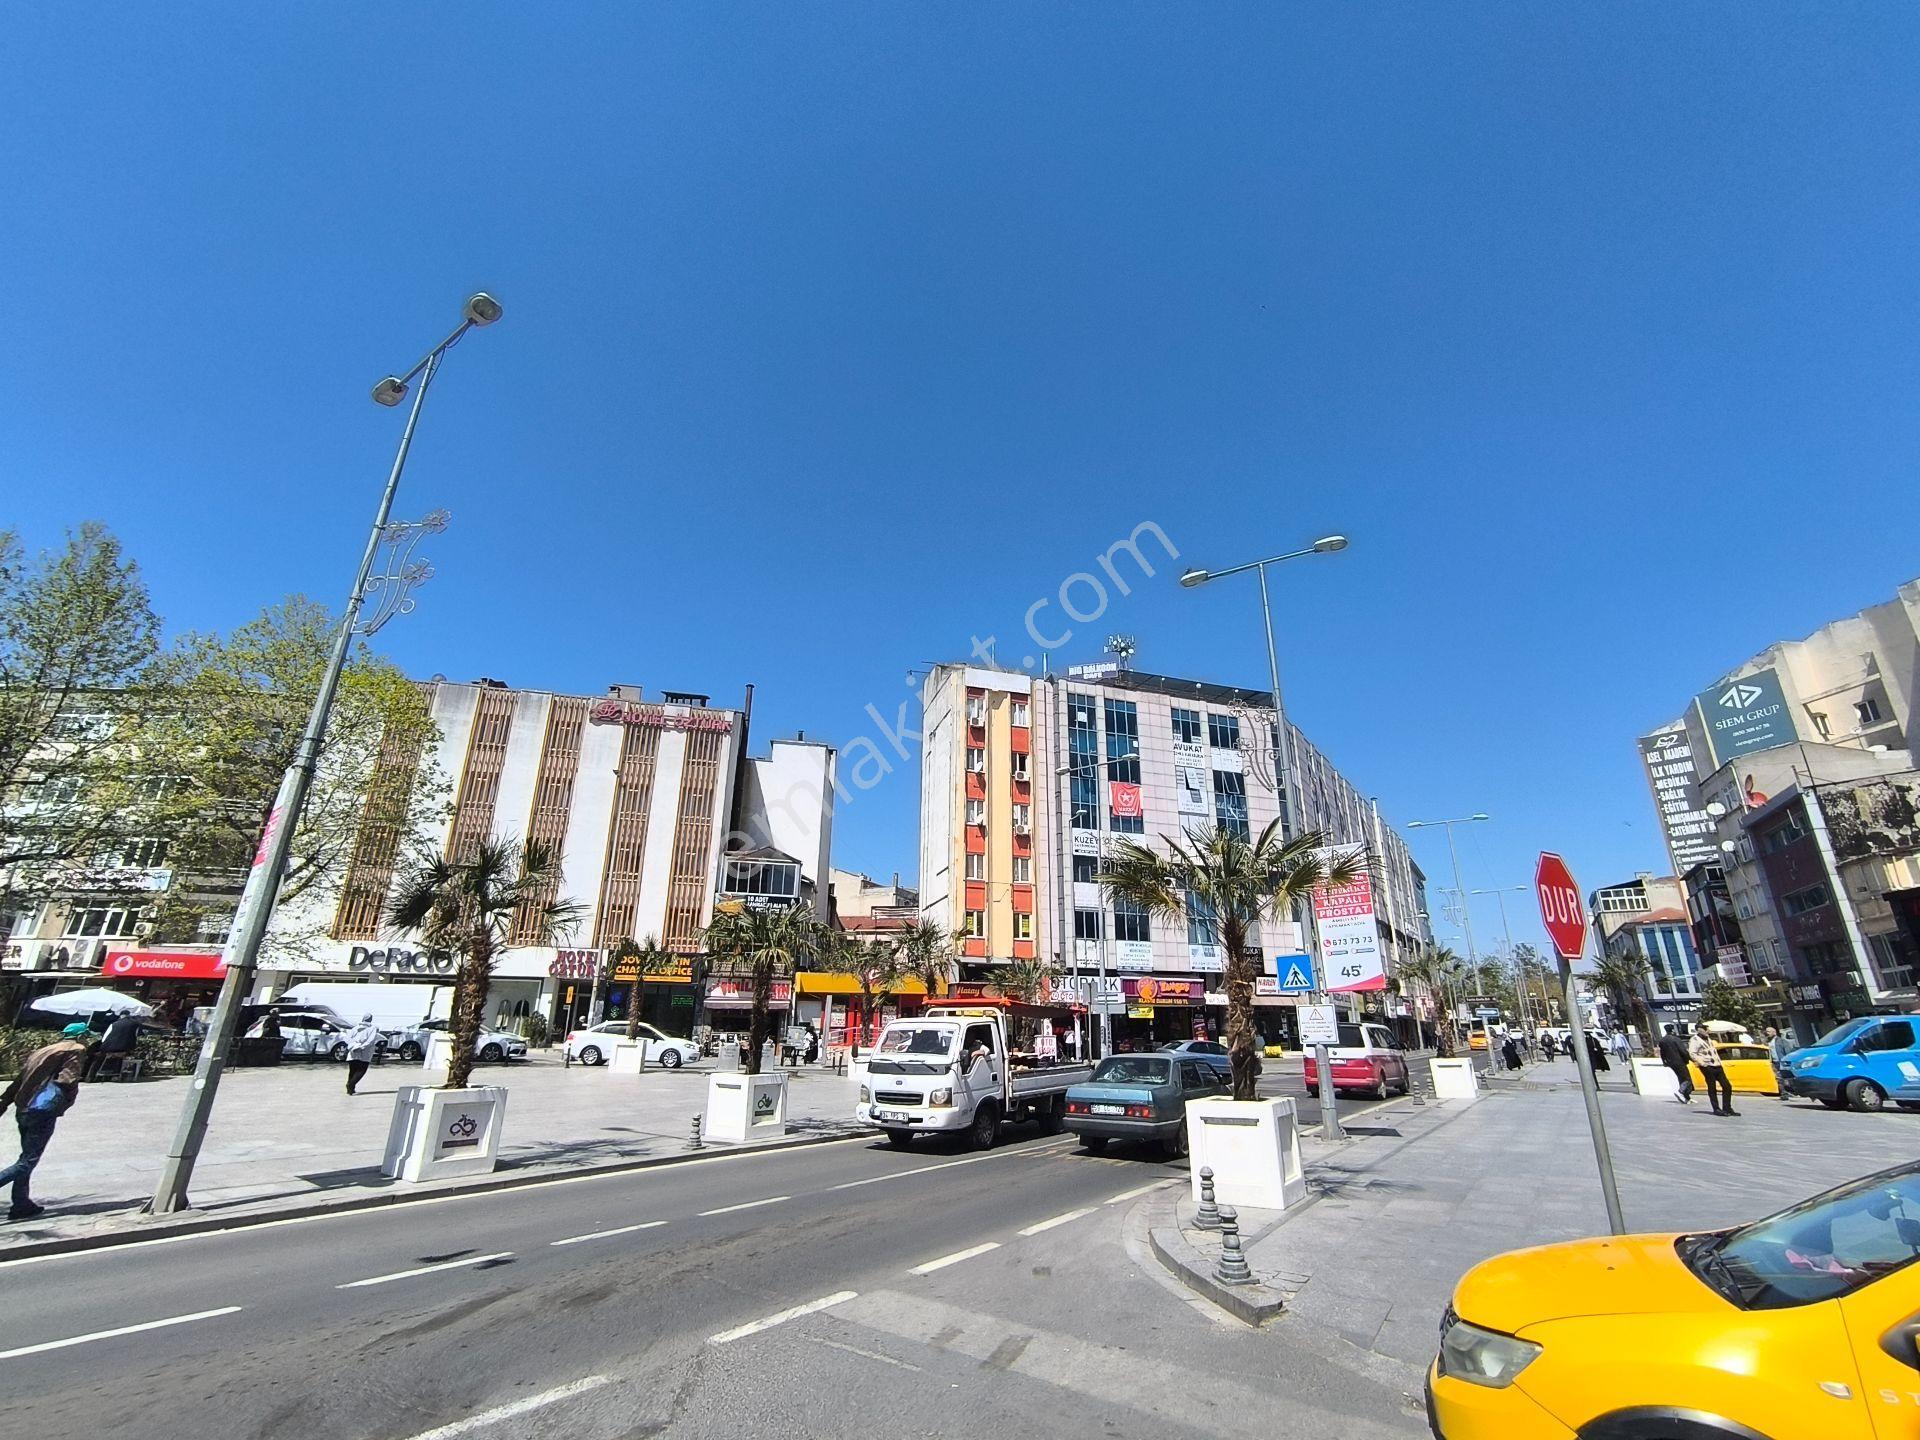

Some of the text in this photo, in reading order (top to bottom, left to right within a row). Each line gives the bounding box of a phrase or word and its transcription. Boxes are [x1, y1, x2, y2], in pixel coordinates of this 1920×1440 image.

[1715, 704, 1780, 730] SİEM GRUP
[1173, 744, 1203, 753] AVUKAT
[1646, 743, 1692, 764] ASEL AKADEMİ
[1651, 760, 1694, 778] İLK YARDIM
[1074, 836, 1099, 845] KUZEY
[1323, 895, 1362, 907] KAPALI
[1540, 884, 1582, 925] DUR
[1320, 905, 1369, 918] PROSTAT
[135, 959, 185, 970] vodafone
[615, 965, 693, 976] CHAGE OFFICE
[1050, 976, 1118, 991] OTOPK
